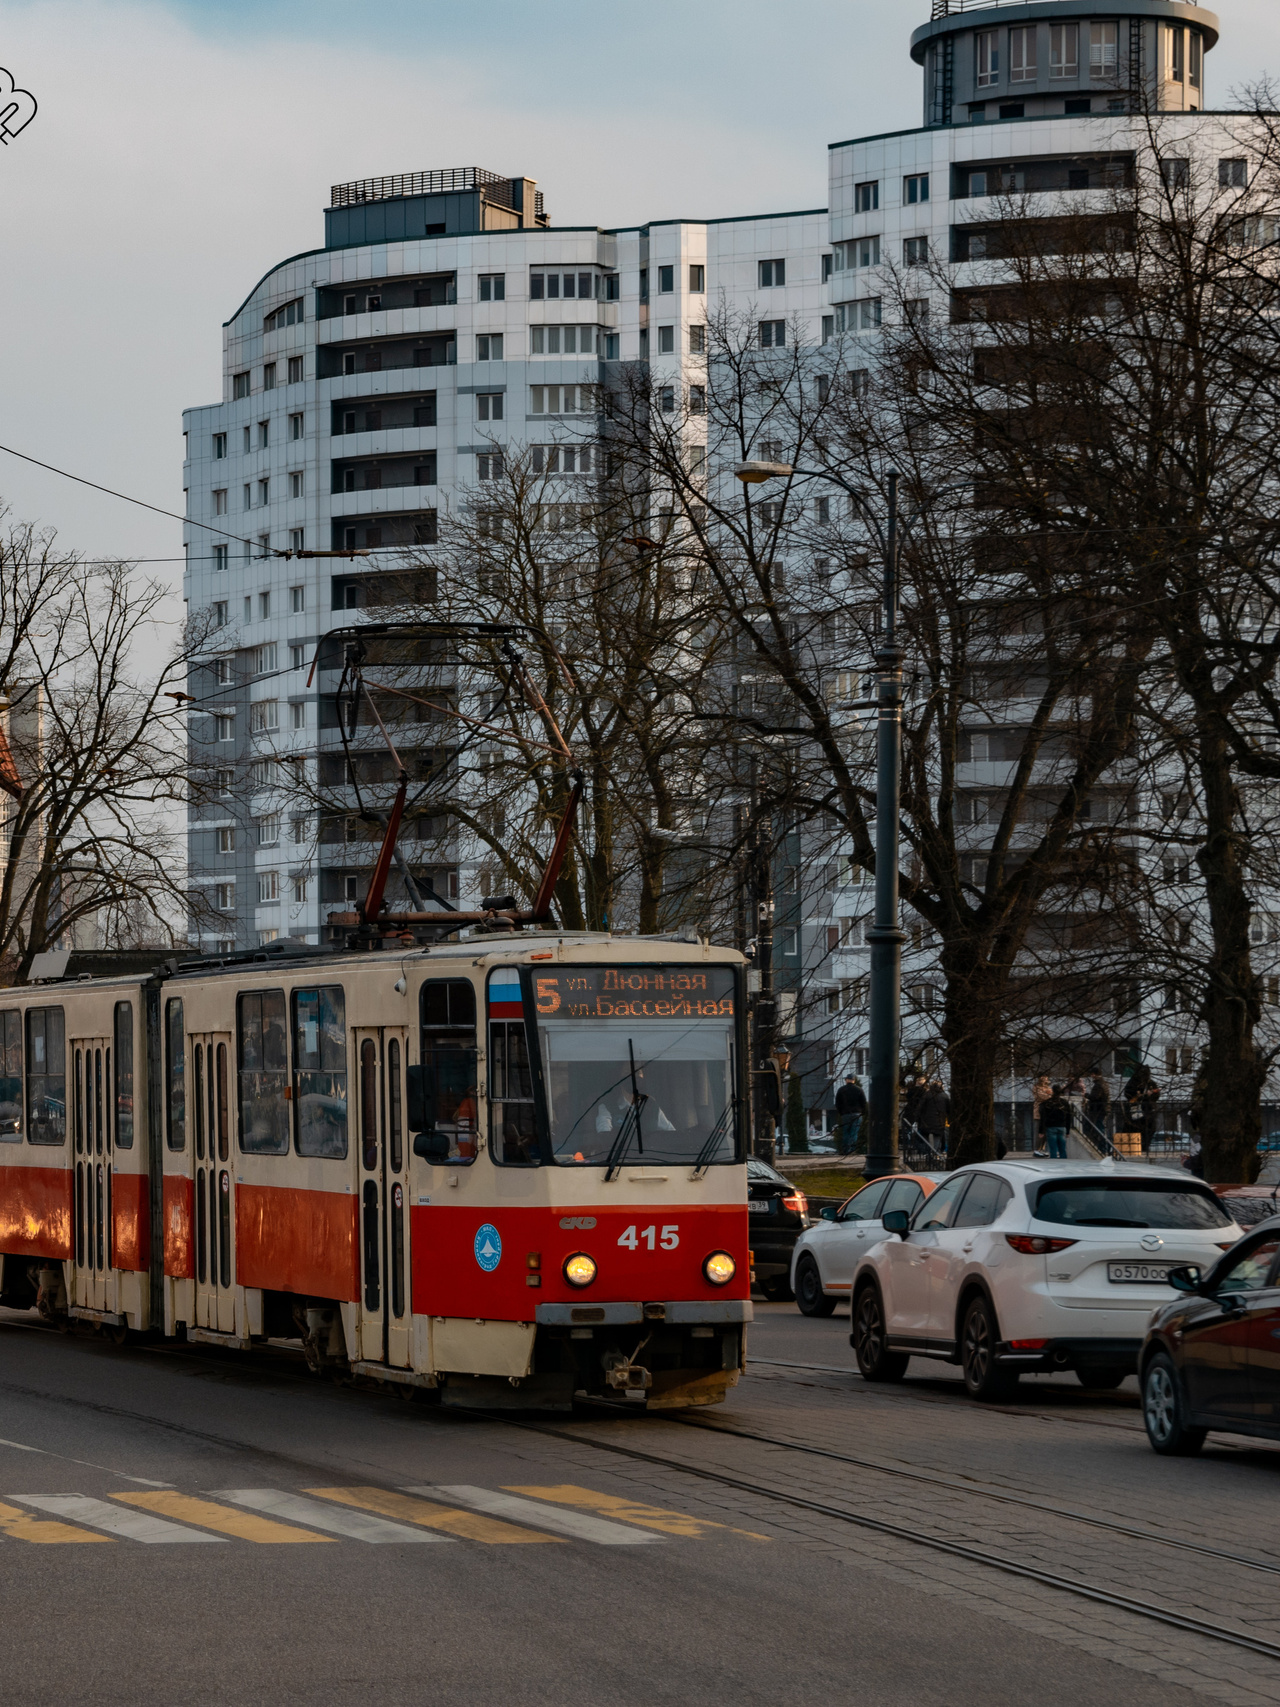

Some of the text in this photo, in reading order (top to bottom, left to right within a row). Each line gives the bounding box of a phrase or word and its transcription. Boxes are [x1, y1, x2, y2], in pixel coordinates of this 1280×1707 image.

[566, 970, 707, 991] ул. Дюнная
[536, 978, 562, 1014] 5
[617, 1225, 680, 1251] 415
